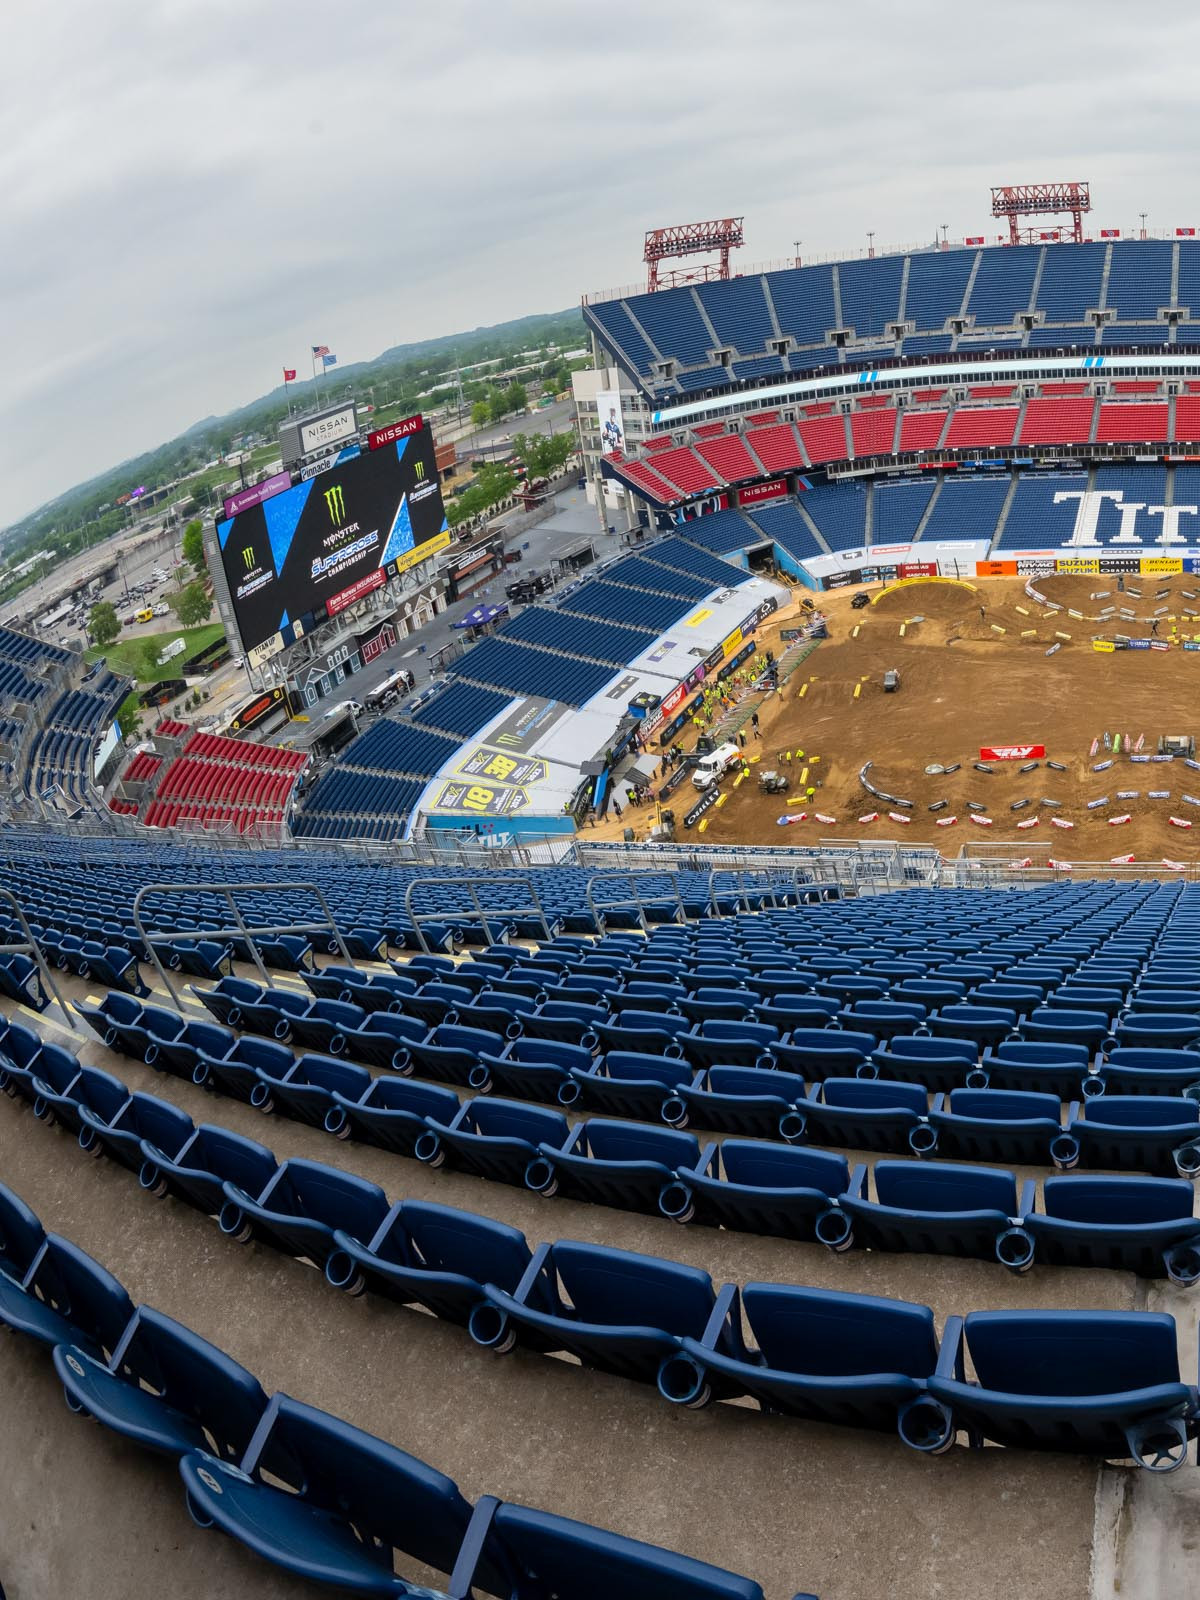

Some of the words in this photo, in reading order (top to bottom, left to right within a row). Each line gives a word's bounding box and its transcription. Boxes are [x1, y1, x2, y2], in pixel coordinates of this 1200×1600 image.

[308, 416, 348, 438] NISSAN
[376, 420, 417, 444] NISSAN
[302, 460, 331, 480] Pinnacle
[744, 483, 781, 497] NISSAN
[323, 522, 360, 547] MONSTER
[311, 529, 379, 579] SUPERCROSS
[327, 550, 367, 577] CHAMPIONSHIP
[254, 640, 269, 656] TITAN
[268, 636, 277, 647] UP
[991, 747, 1034, 757] FLY
[483, 754, 518, 781] 38
[462, 786, 495, 811] 18
[694, 789, 719, 816] OAKLEY
